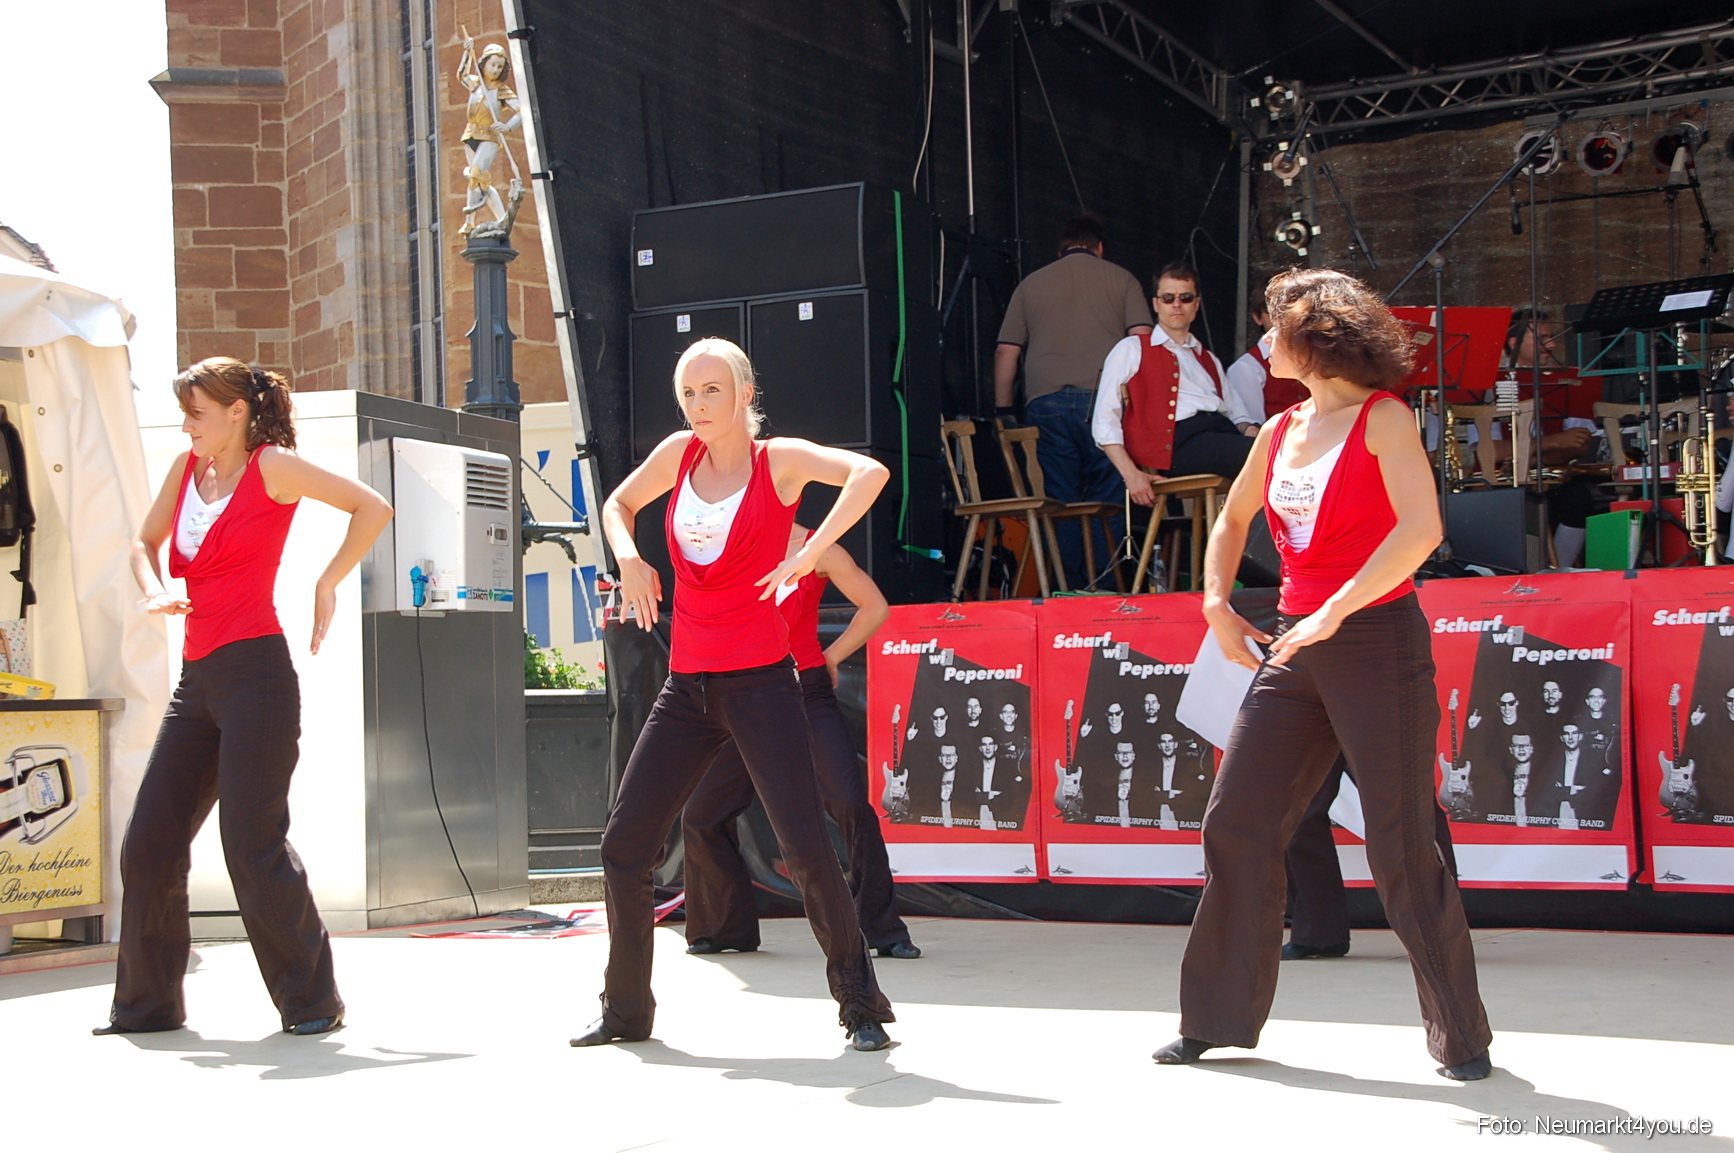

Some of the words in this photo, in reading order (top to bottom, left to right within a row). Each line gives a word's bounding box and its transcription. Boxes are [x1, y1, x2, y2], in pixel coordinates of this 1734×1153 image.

[1433, 615, 1503, 634] Scharf
[1652, 606, 1731, 625] Scharf
[1053, 631, 1112, 649] Scharf
[1718, 625, 1734, 637] w
[881, 638, 938, 655] Scharf
[1511, 642, 1615, 666] Peperoni
[943, 664, 1023, 684] Peperoni
[1118, 661, 1194, 679] Peperon
[920, 816, 944, 824] SPIDER
[997, 821, 1018, 829] BAND
[1094, 815, 1121, 824] SPIDER
[1180, 820, 1201, 829] BAND
[1487, 813, 1516, 823] SPIDER
[1580, 820, 1605, 828] BAND
[1712, 814, 1734, 824] SPID
[27, 847, 93, 878] hochfeine
[0, 878, 83, 909] Biergenuss
